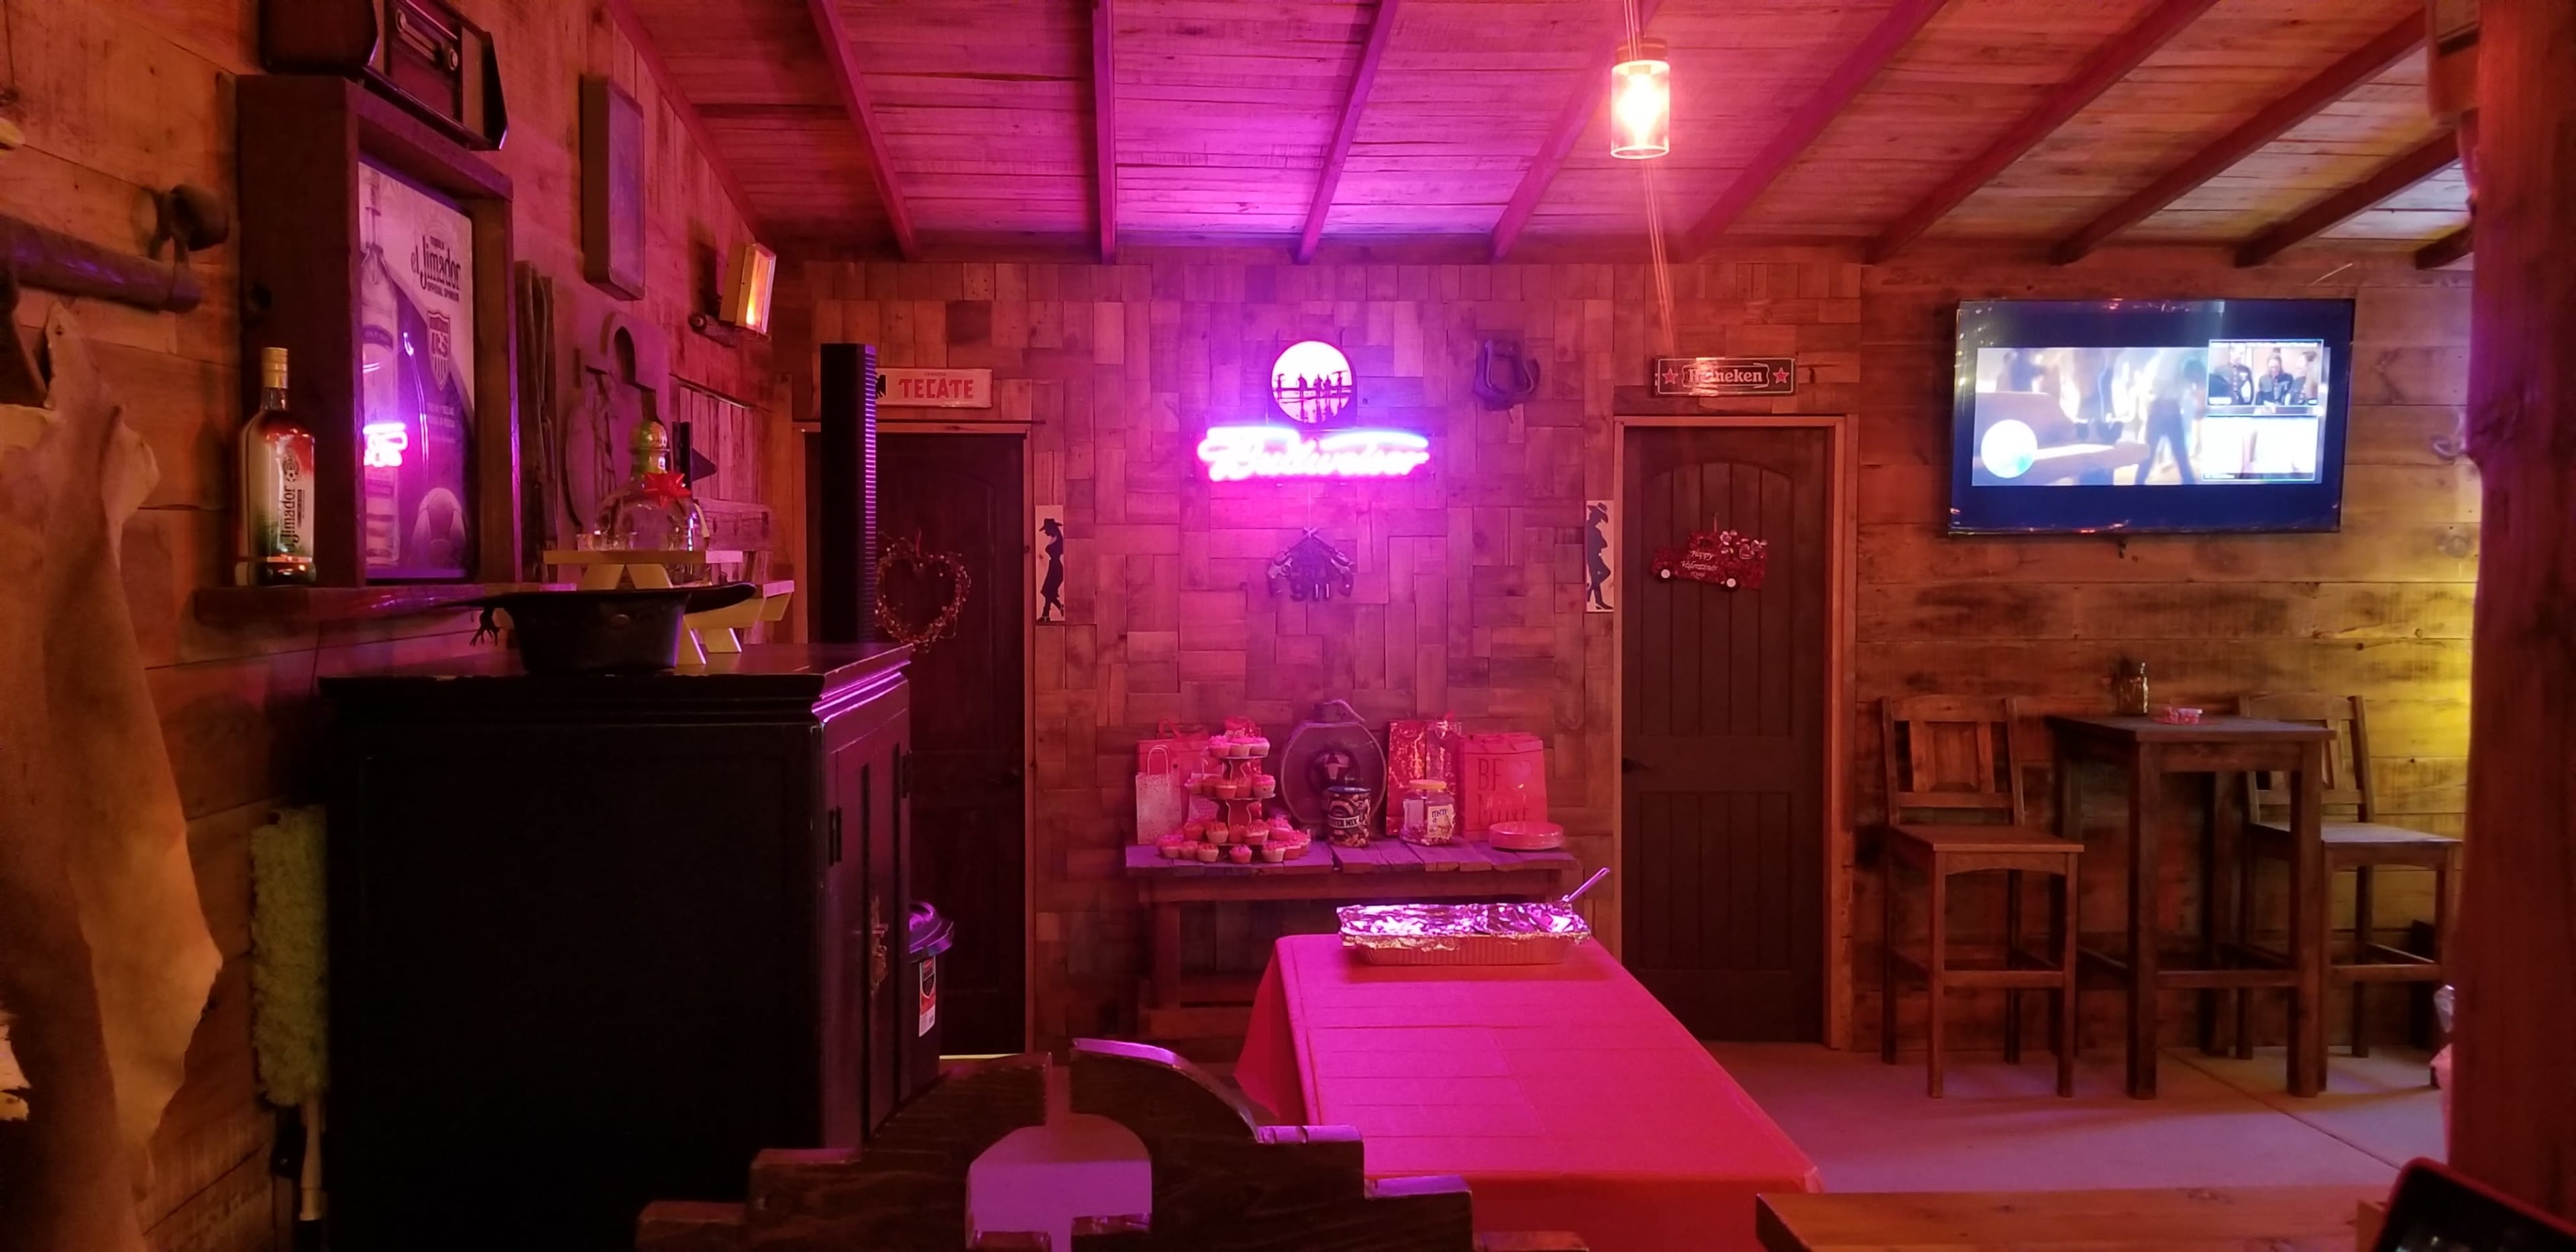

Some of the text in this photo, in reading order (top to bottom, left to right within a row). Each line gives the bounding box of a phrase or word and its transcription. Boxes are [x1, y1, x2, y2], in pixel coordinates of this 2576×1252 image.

[411, 235, 461, 290] el Jimador
[898, 377, 973, 399] TECATE
